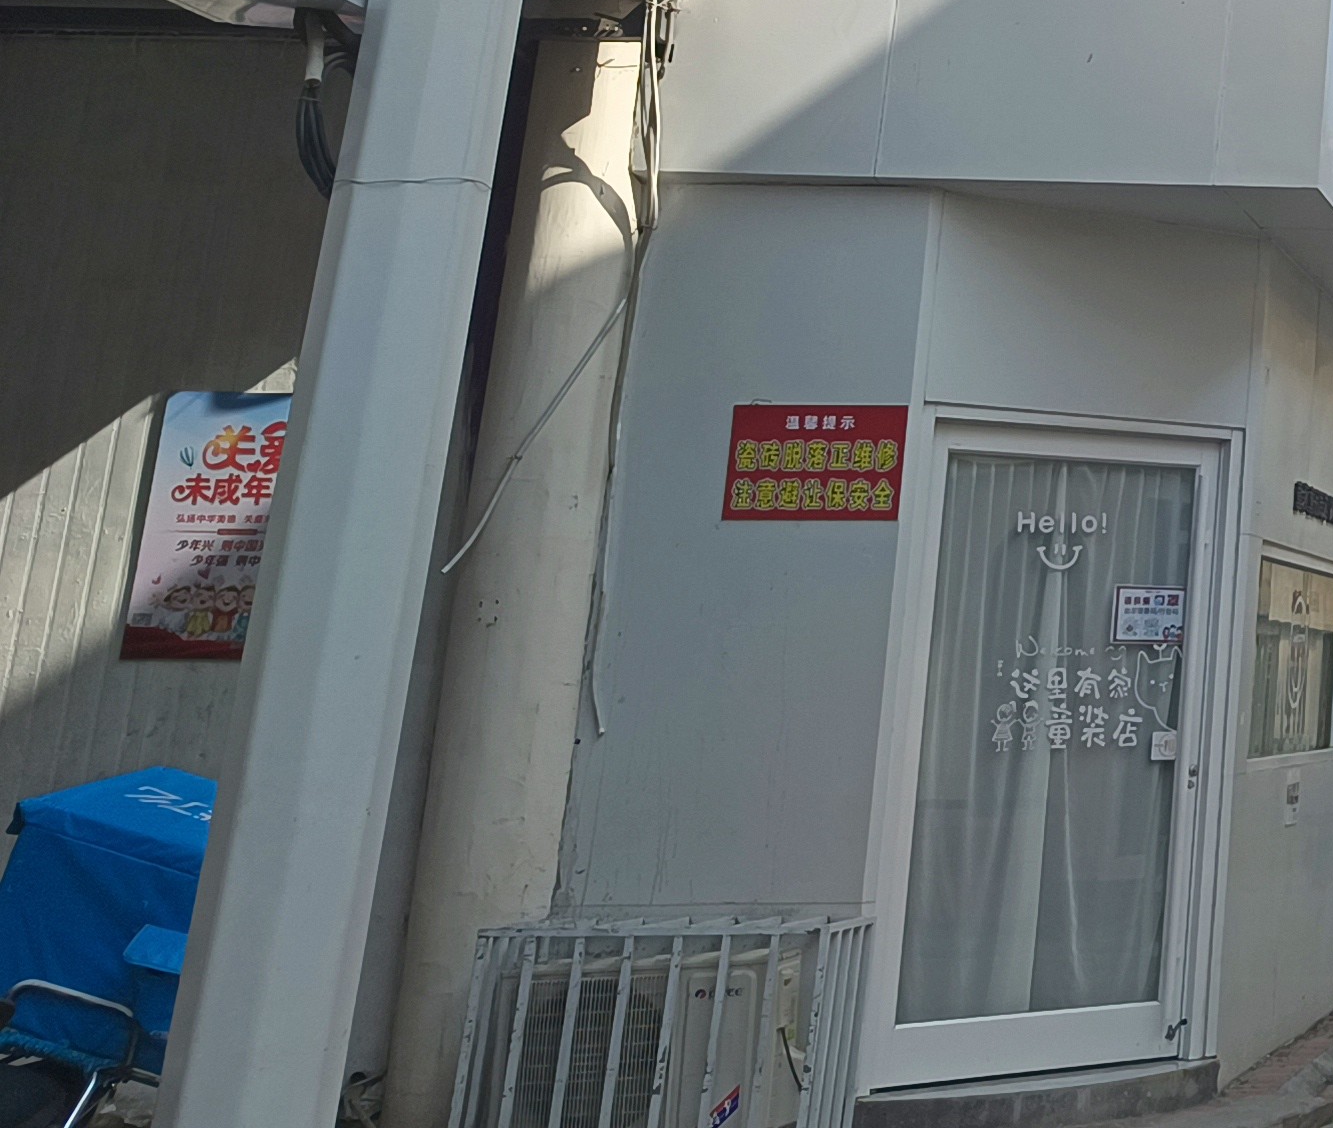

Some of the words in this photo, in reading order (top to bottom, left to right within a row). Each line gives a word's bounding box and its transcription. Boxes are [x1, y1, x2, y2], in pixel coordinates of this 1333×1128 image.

[785, 415, 856, 430] 温馨提示
[736, 439, 898, 472] 瓷砖脱落正维修
[171, 473, 273, 506] 未成年
[731, 478, 894, 511] 注意避让保安全
[1017, 511, 1107, 534] Hello!
[1045, 703, 1143, 749] 童装店
